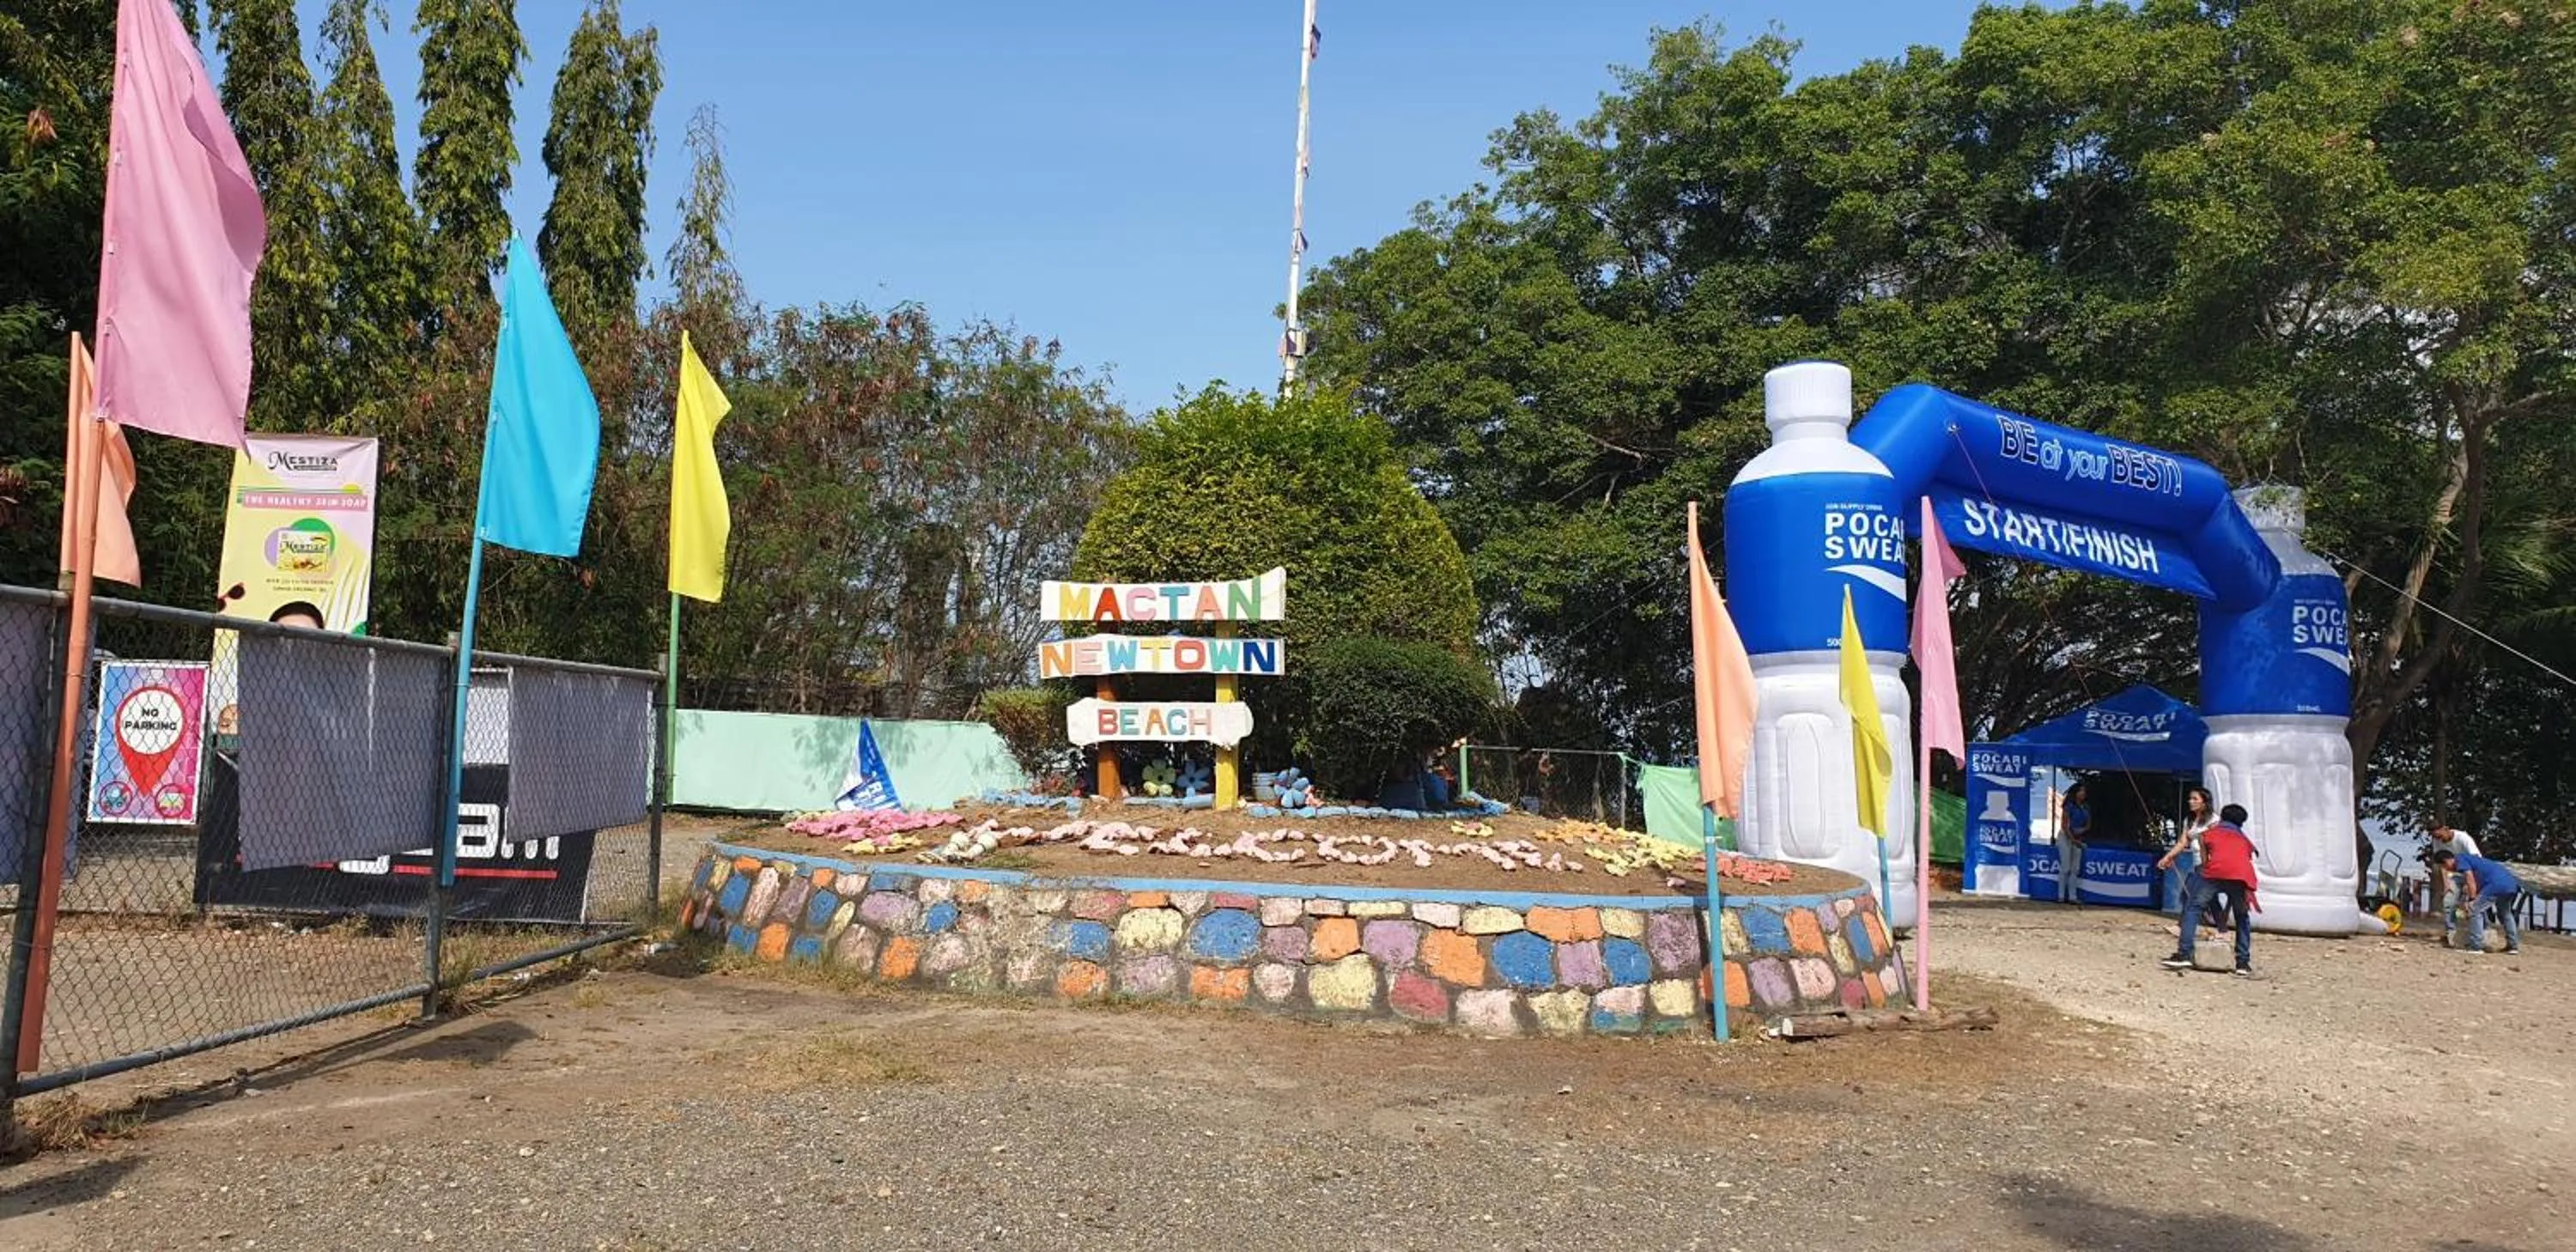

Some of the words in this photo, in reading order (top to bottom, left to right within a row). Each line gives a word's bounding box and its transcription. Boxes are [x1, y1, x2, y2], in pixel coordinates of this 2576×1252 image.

[1996, 414, 2038, 464] BE
[2040, 439, 2063, 471] at
[2066, 447, 2109, 481] your
[2105, 443, 2182, 496] BEST!
[1825, 513, 1904, 541] POCA
[1825, 535, 1905, 564] SWEA
[1059, 576, 1261, 623] MACTAN
[1042, 640, 1275, 677] NEWTOWN
[125, 720, 178, 731] PARKING
[142, 708, 159, 717] NO
[1097, 708, 1212, 736] BEACH
[1972, 753, 2027, 765] POCARI
[1972, 762, 2021, 773] SWEAT
[2086, 860, 2150, 878] SWEAT
